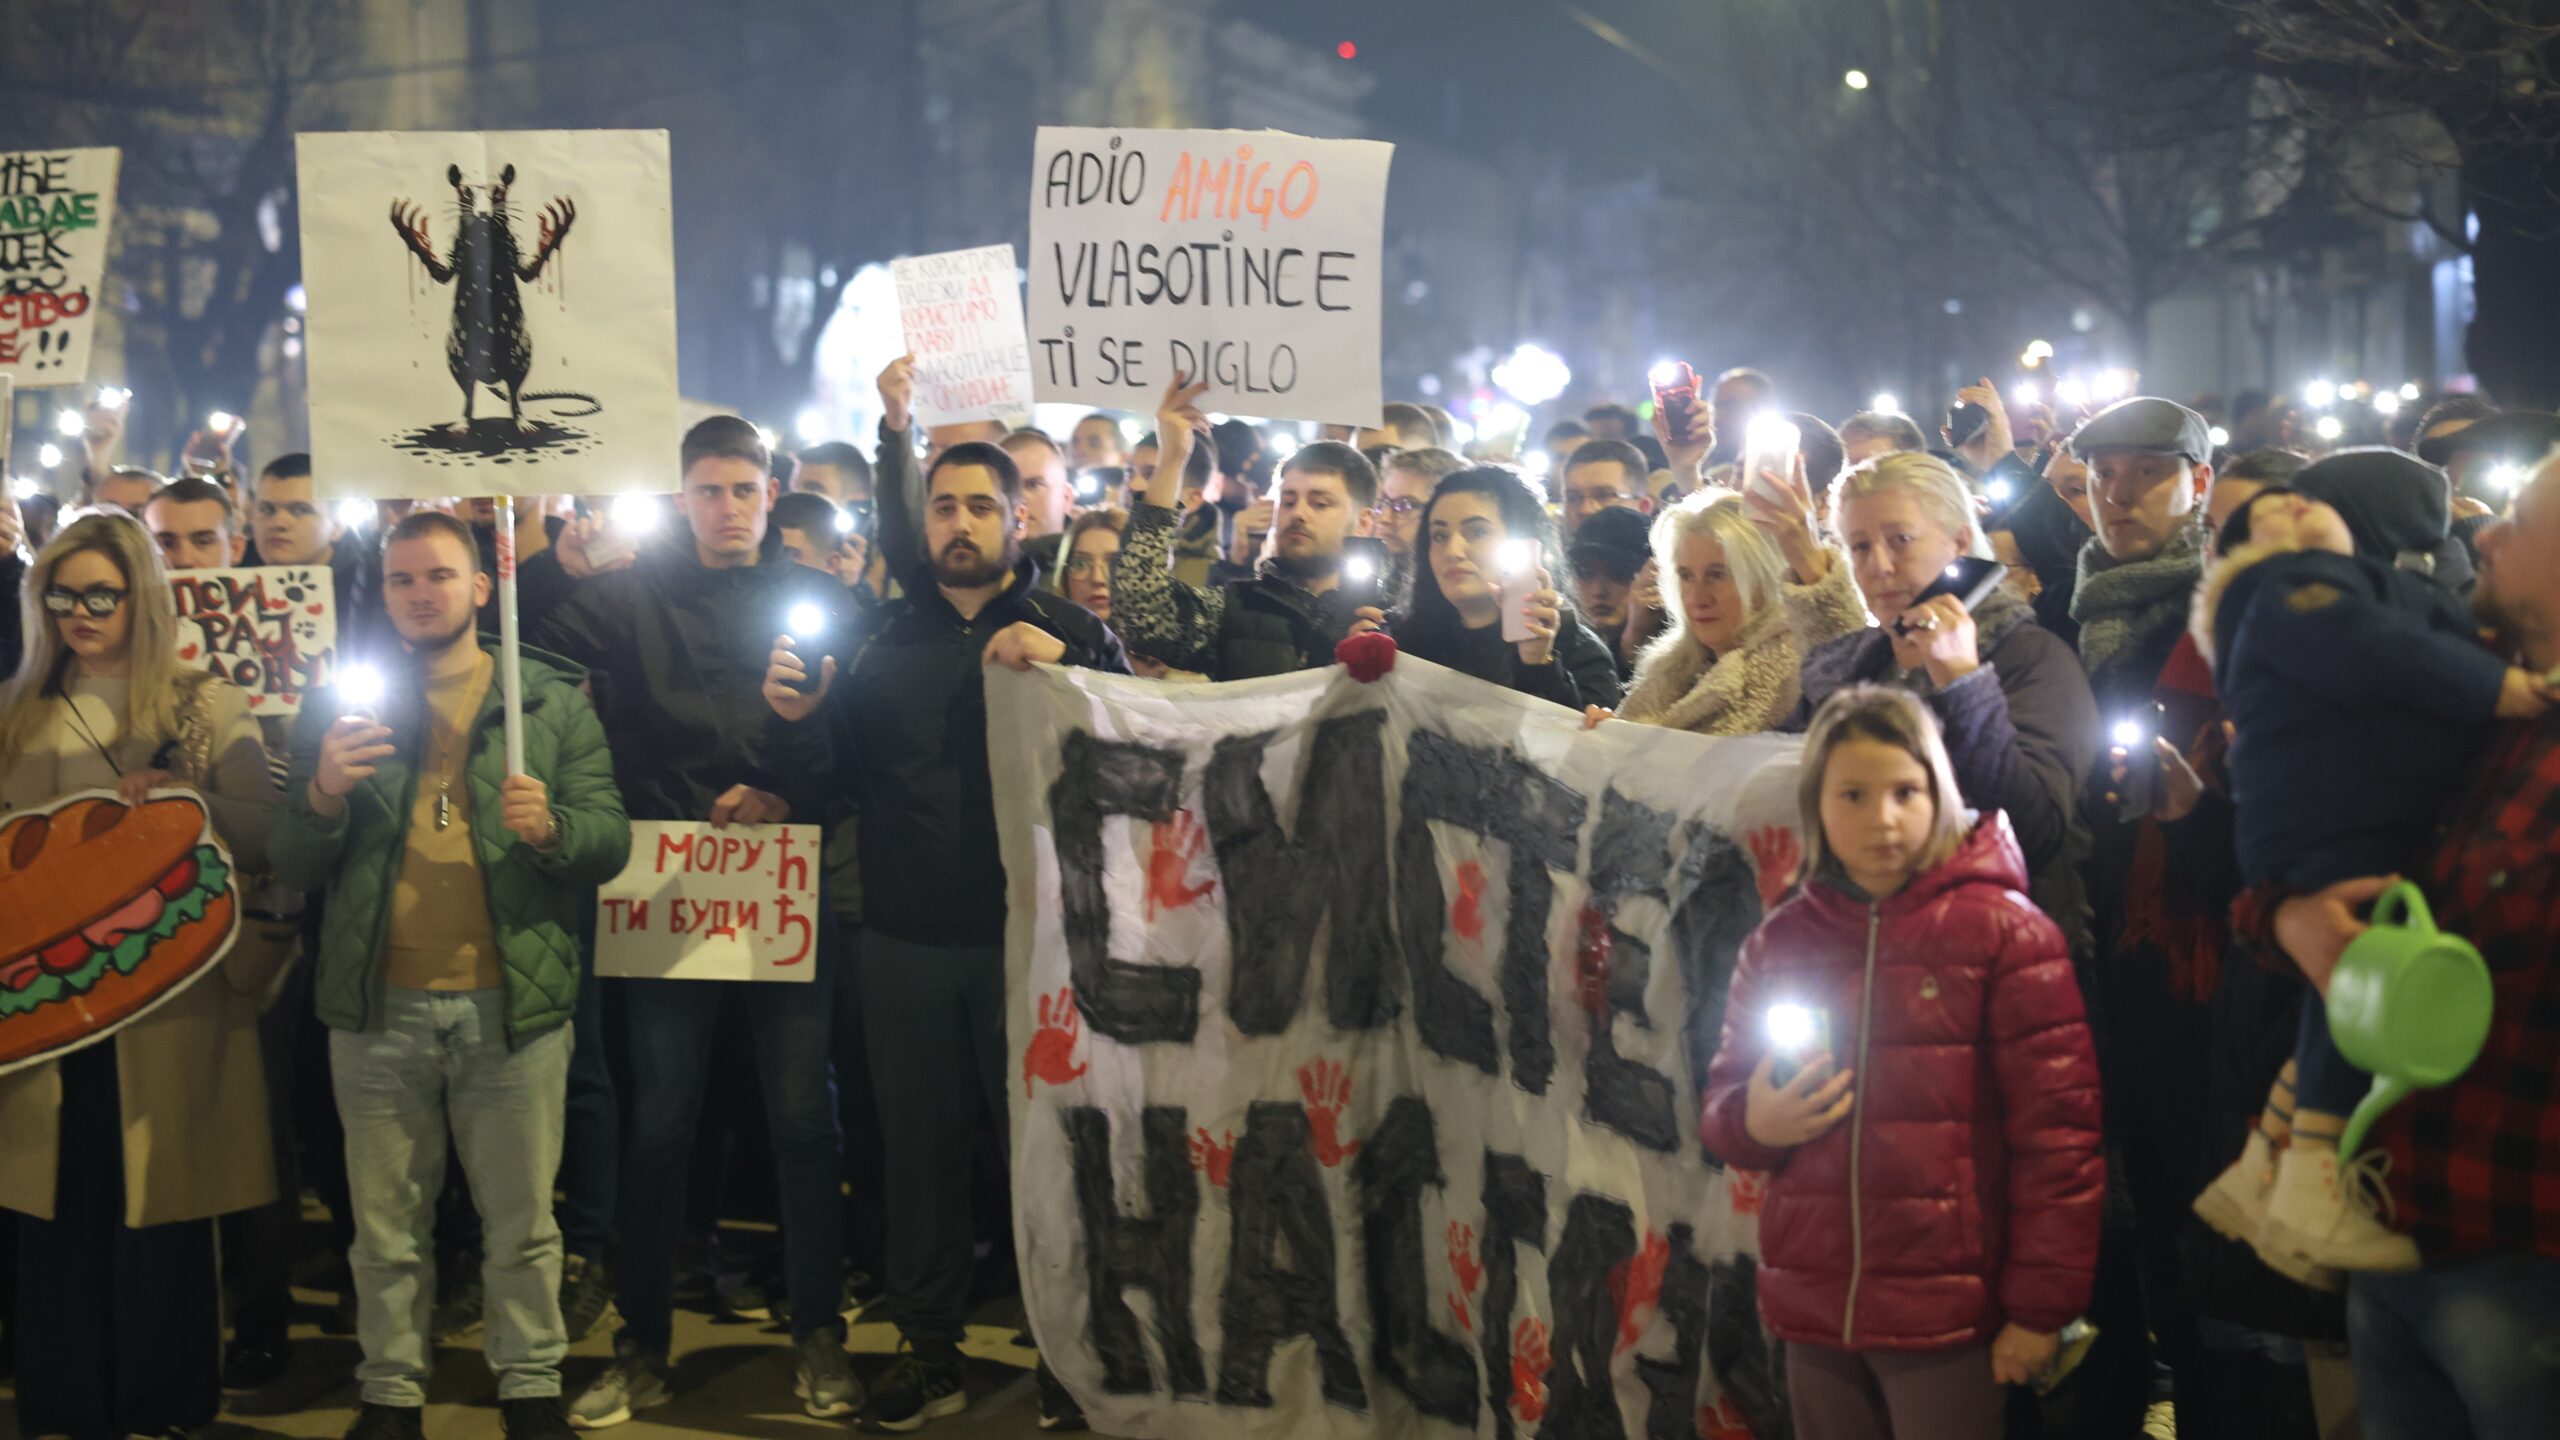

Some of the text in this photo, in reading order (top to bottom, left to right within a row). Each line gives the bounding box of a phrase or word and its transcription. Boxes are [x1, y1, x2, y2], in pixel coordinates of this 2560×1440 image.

[1097, 337, 1148, 387] SE
[1170, 339, 1297, 394] DIGLO
[655, 833, 765, 875] МОРУ
[603, 899, 648, 934] ТИ
[670, 898, 759, 942] БУДИ
